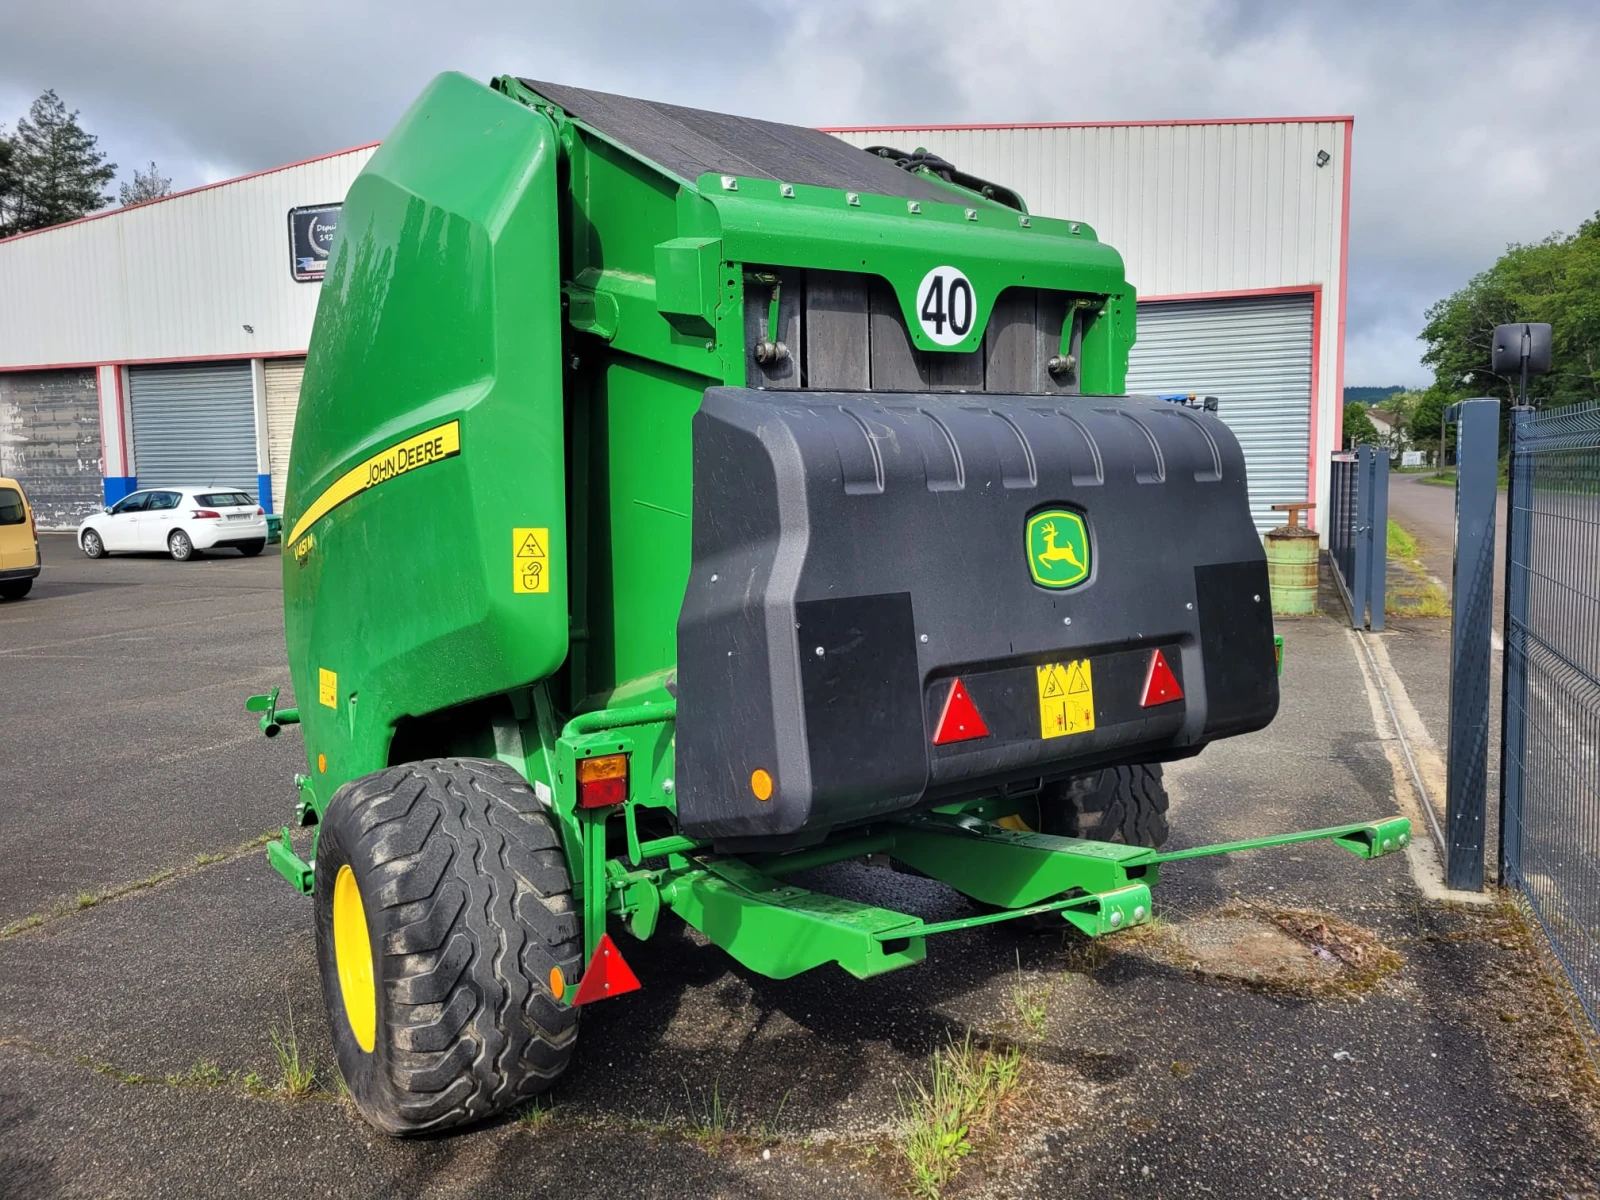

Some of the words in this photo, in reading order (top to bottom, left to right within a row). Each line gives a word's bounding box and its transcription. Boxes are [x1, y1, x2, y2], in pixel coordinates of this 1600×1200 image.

[316, 223, 337, 233] Depui
[319, 234, 334, 242] 192
[921, 275, 972, 336] 40
[366, 456, 395, 485] JOHN
[398, 436, 443, 471] DEERE
